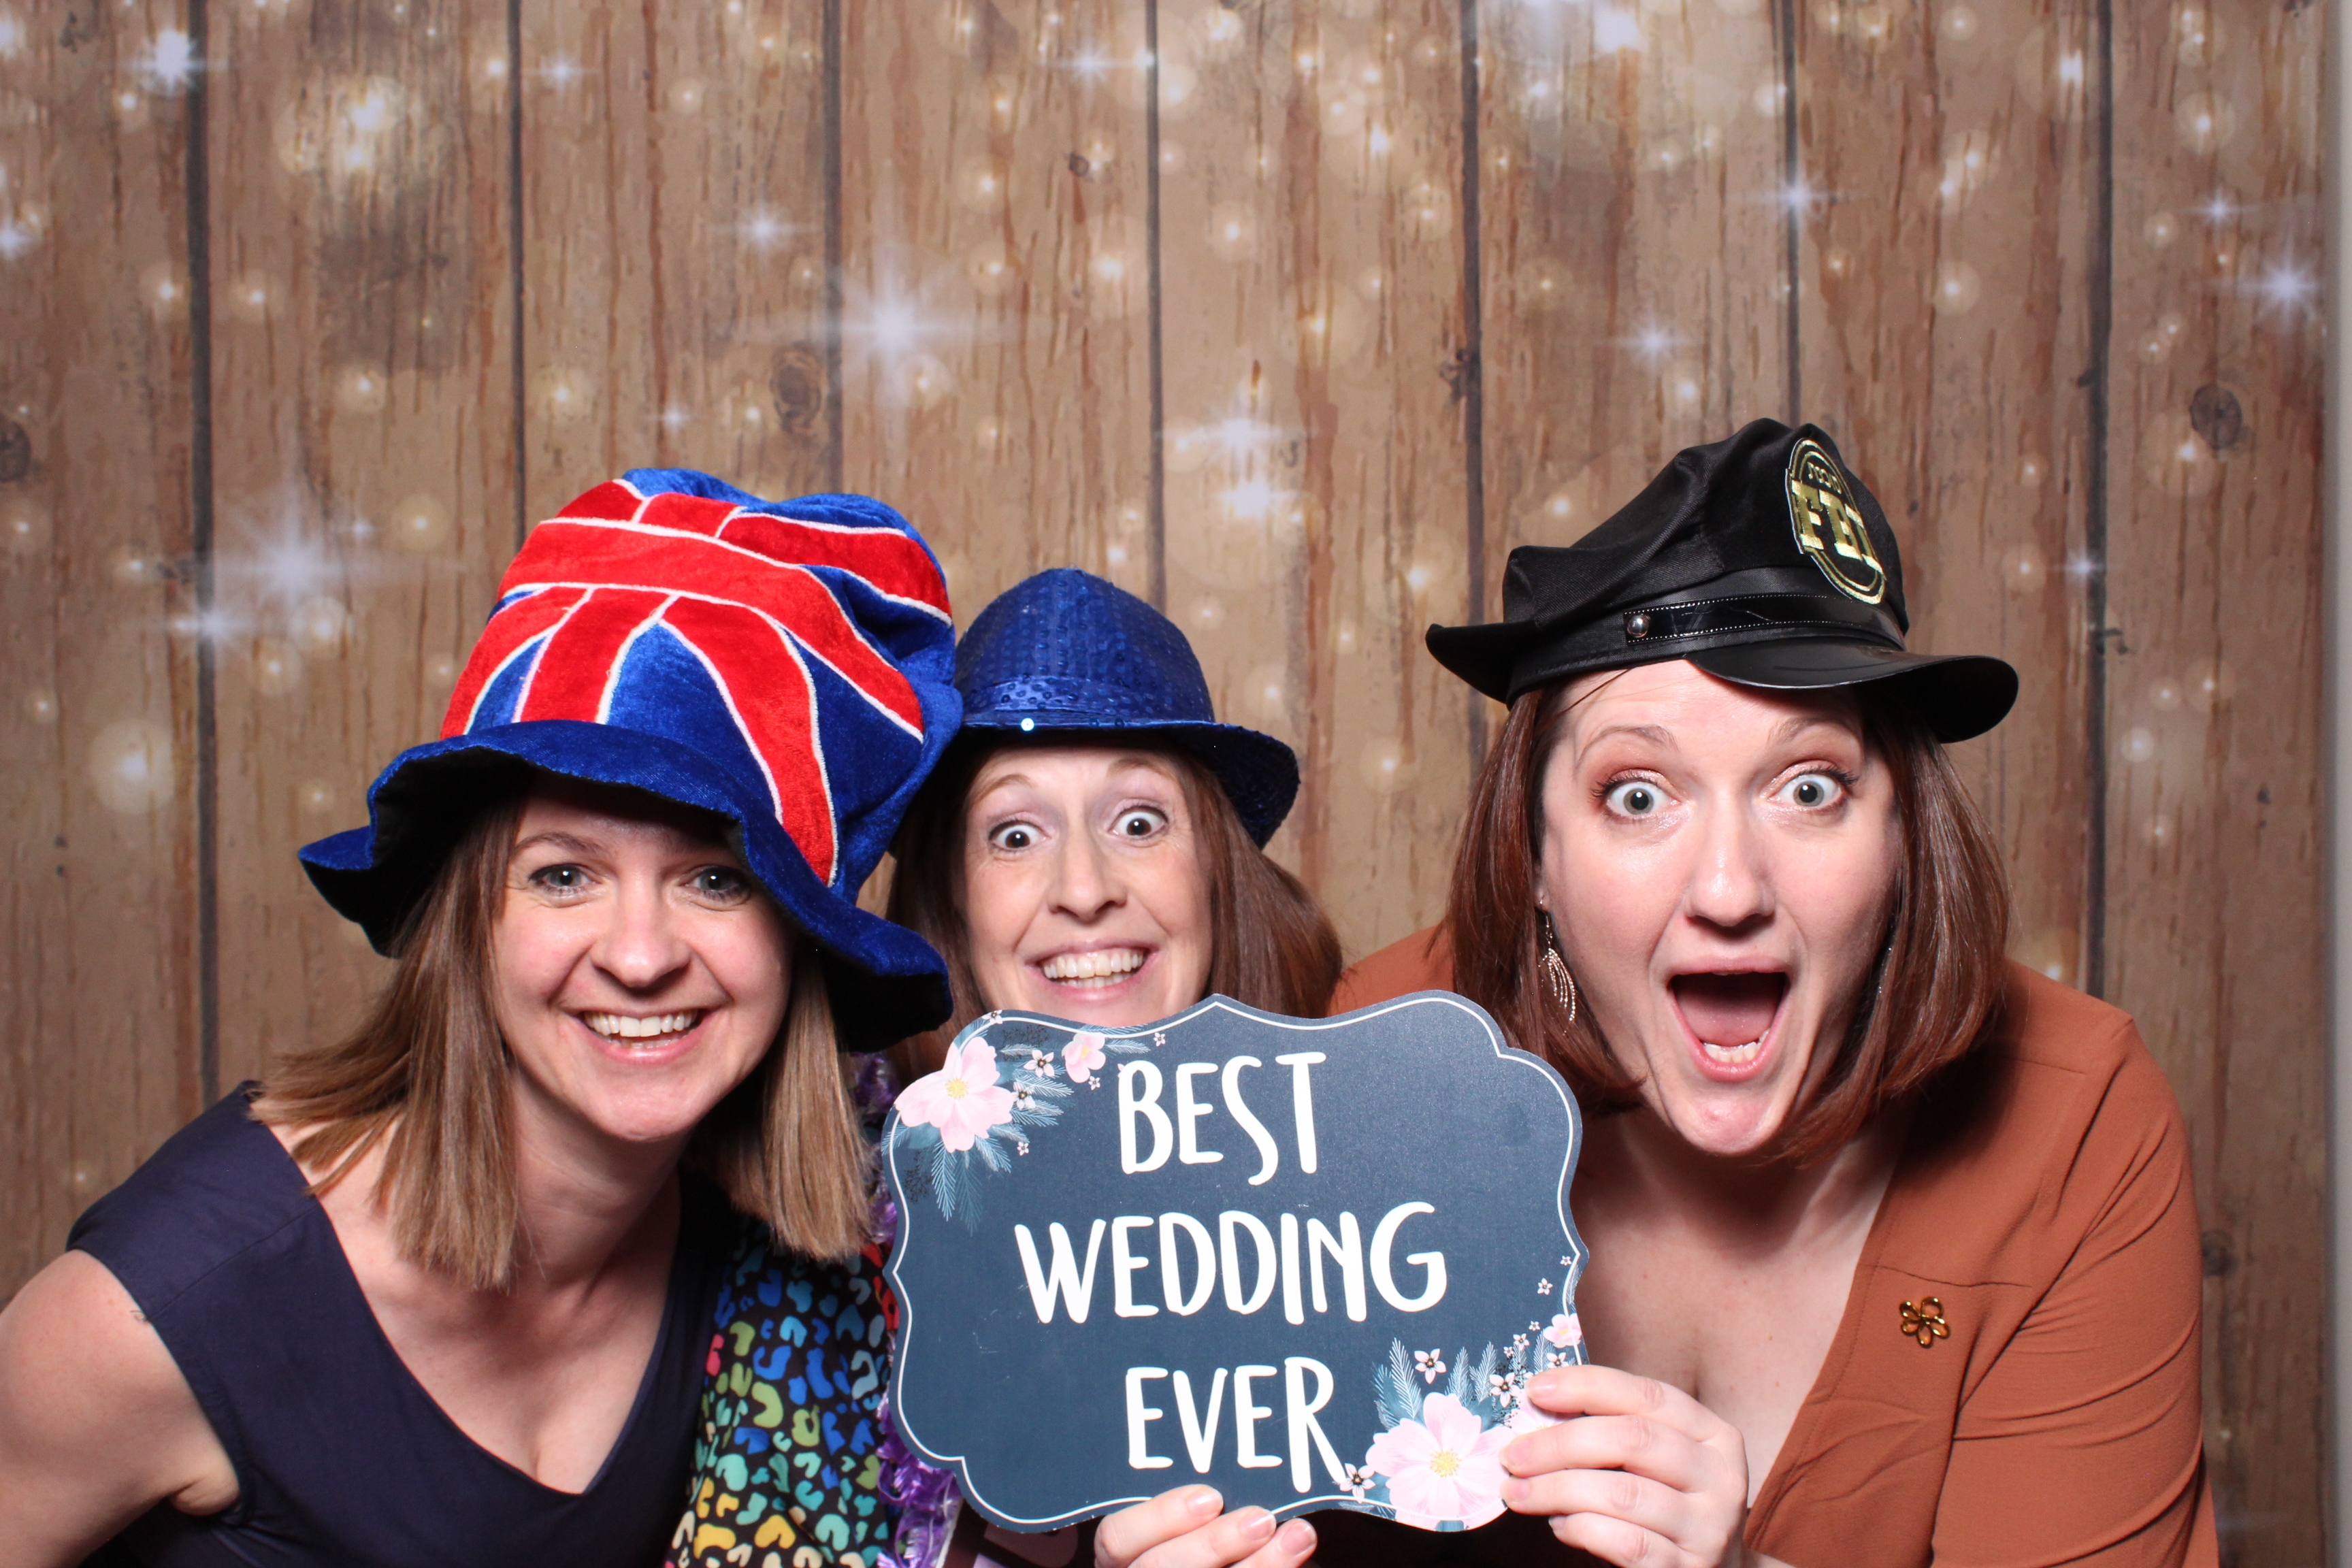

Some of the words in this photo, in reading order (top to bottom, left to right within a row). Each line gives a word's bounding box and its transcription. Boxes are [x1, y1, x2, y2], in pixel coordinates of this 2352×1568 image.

[1791, 479, 1884, 574] FBI
[1117, 1051, 1326, 1186] BEST
[1014, 1201, 1448, 1325] WEDDING
[1126, 1356, 1346, 1494] EVER
